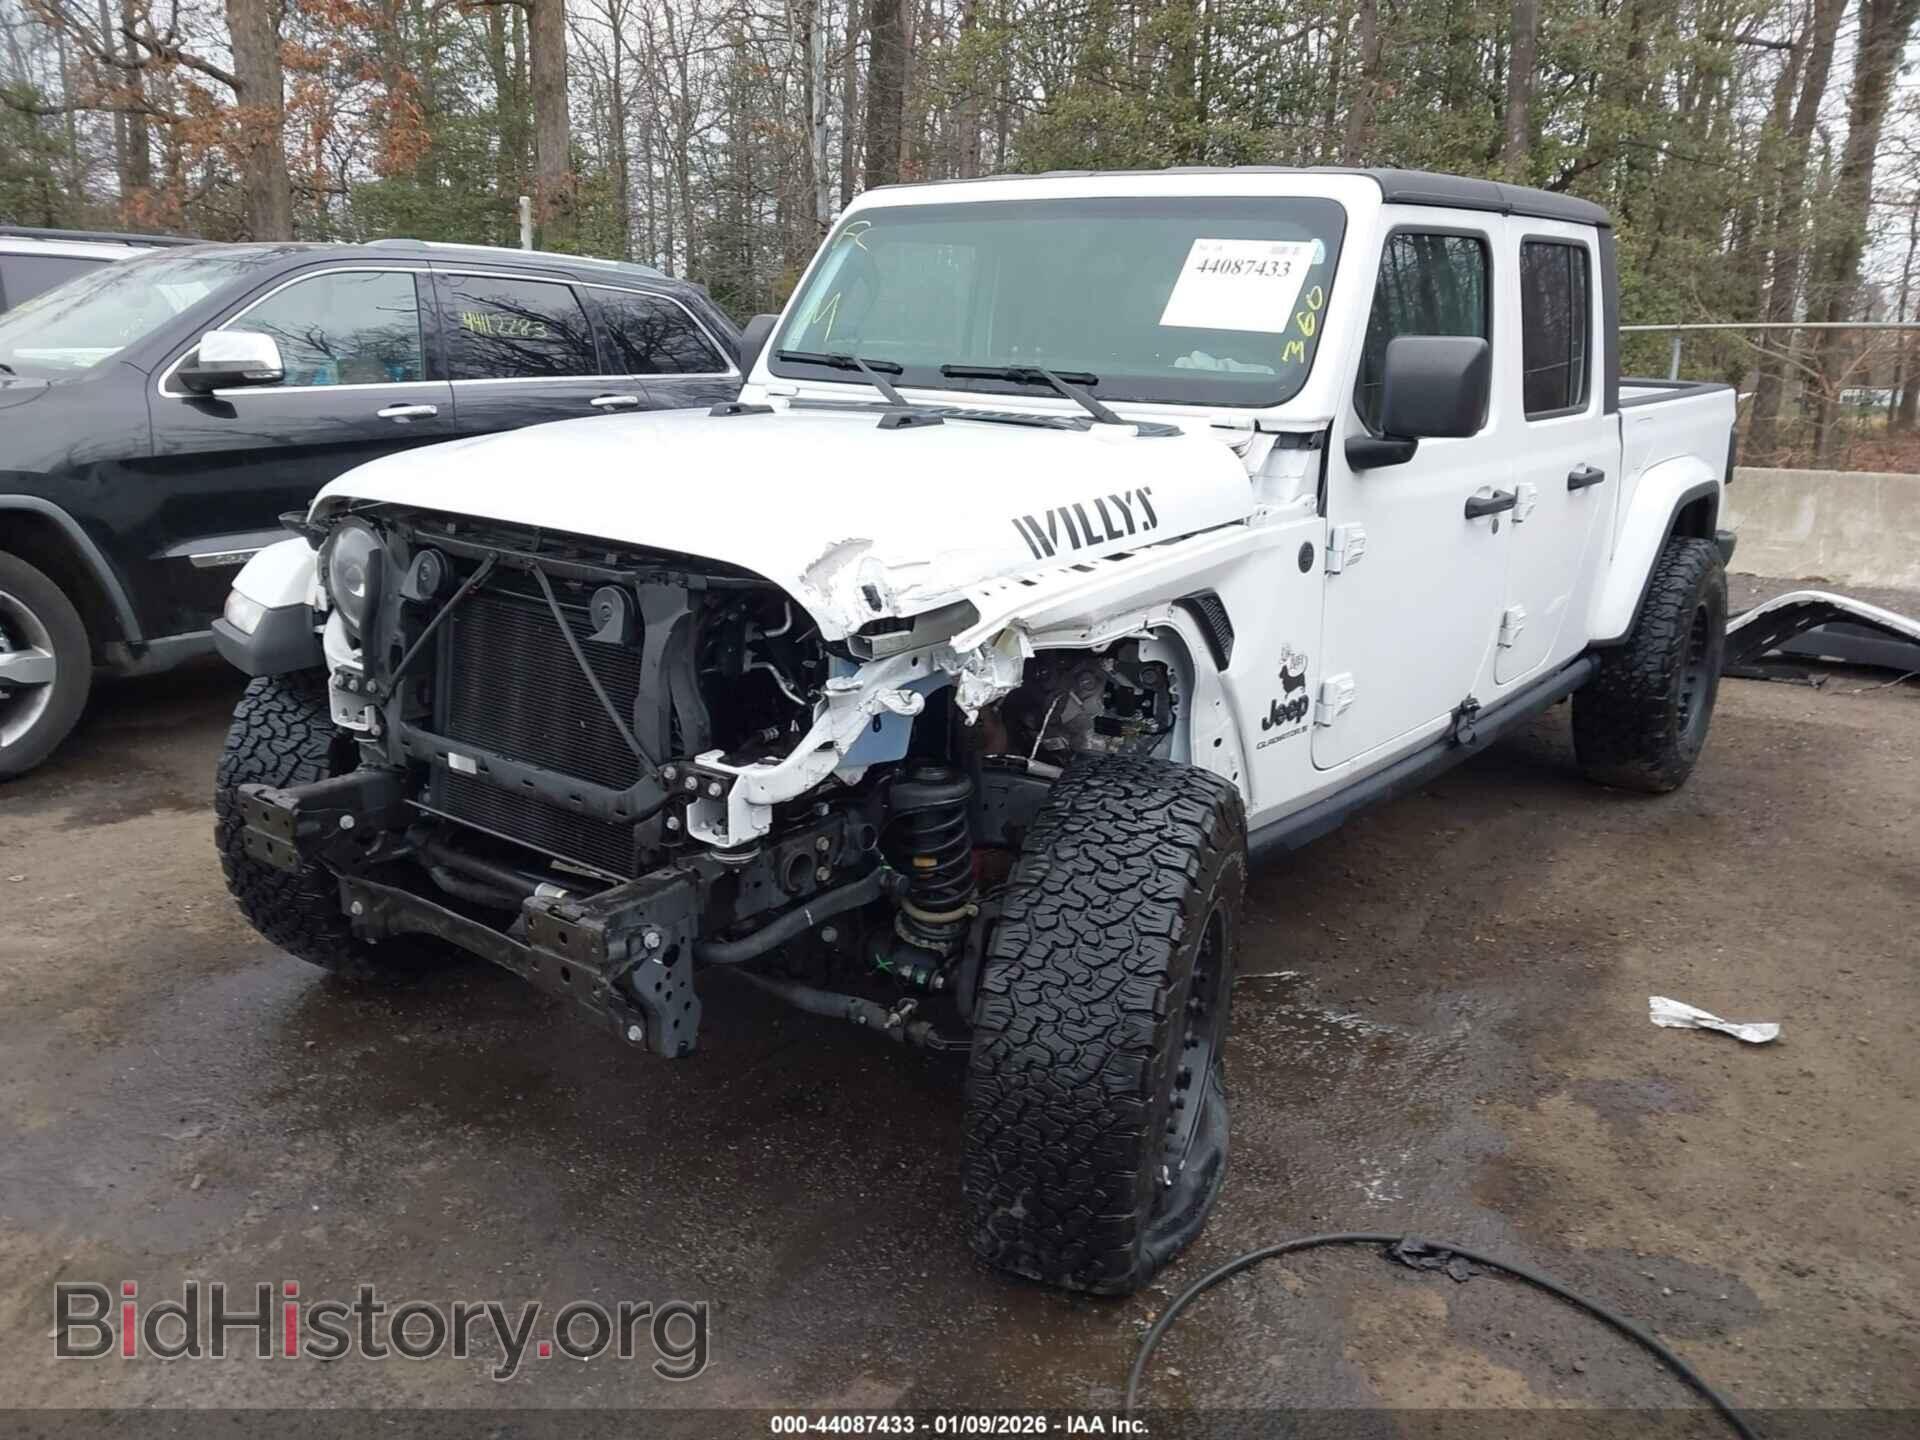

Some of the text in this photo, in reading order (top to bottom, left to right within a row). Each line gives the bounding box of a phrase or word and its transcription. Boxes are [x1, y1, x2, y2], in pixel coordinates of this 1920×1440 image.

[1196, 258, 1292, 277] 44087433
[1011, 486, 1158, 560] WILLYS
[1261, 694, 1309, 732] Jeep
